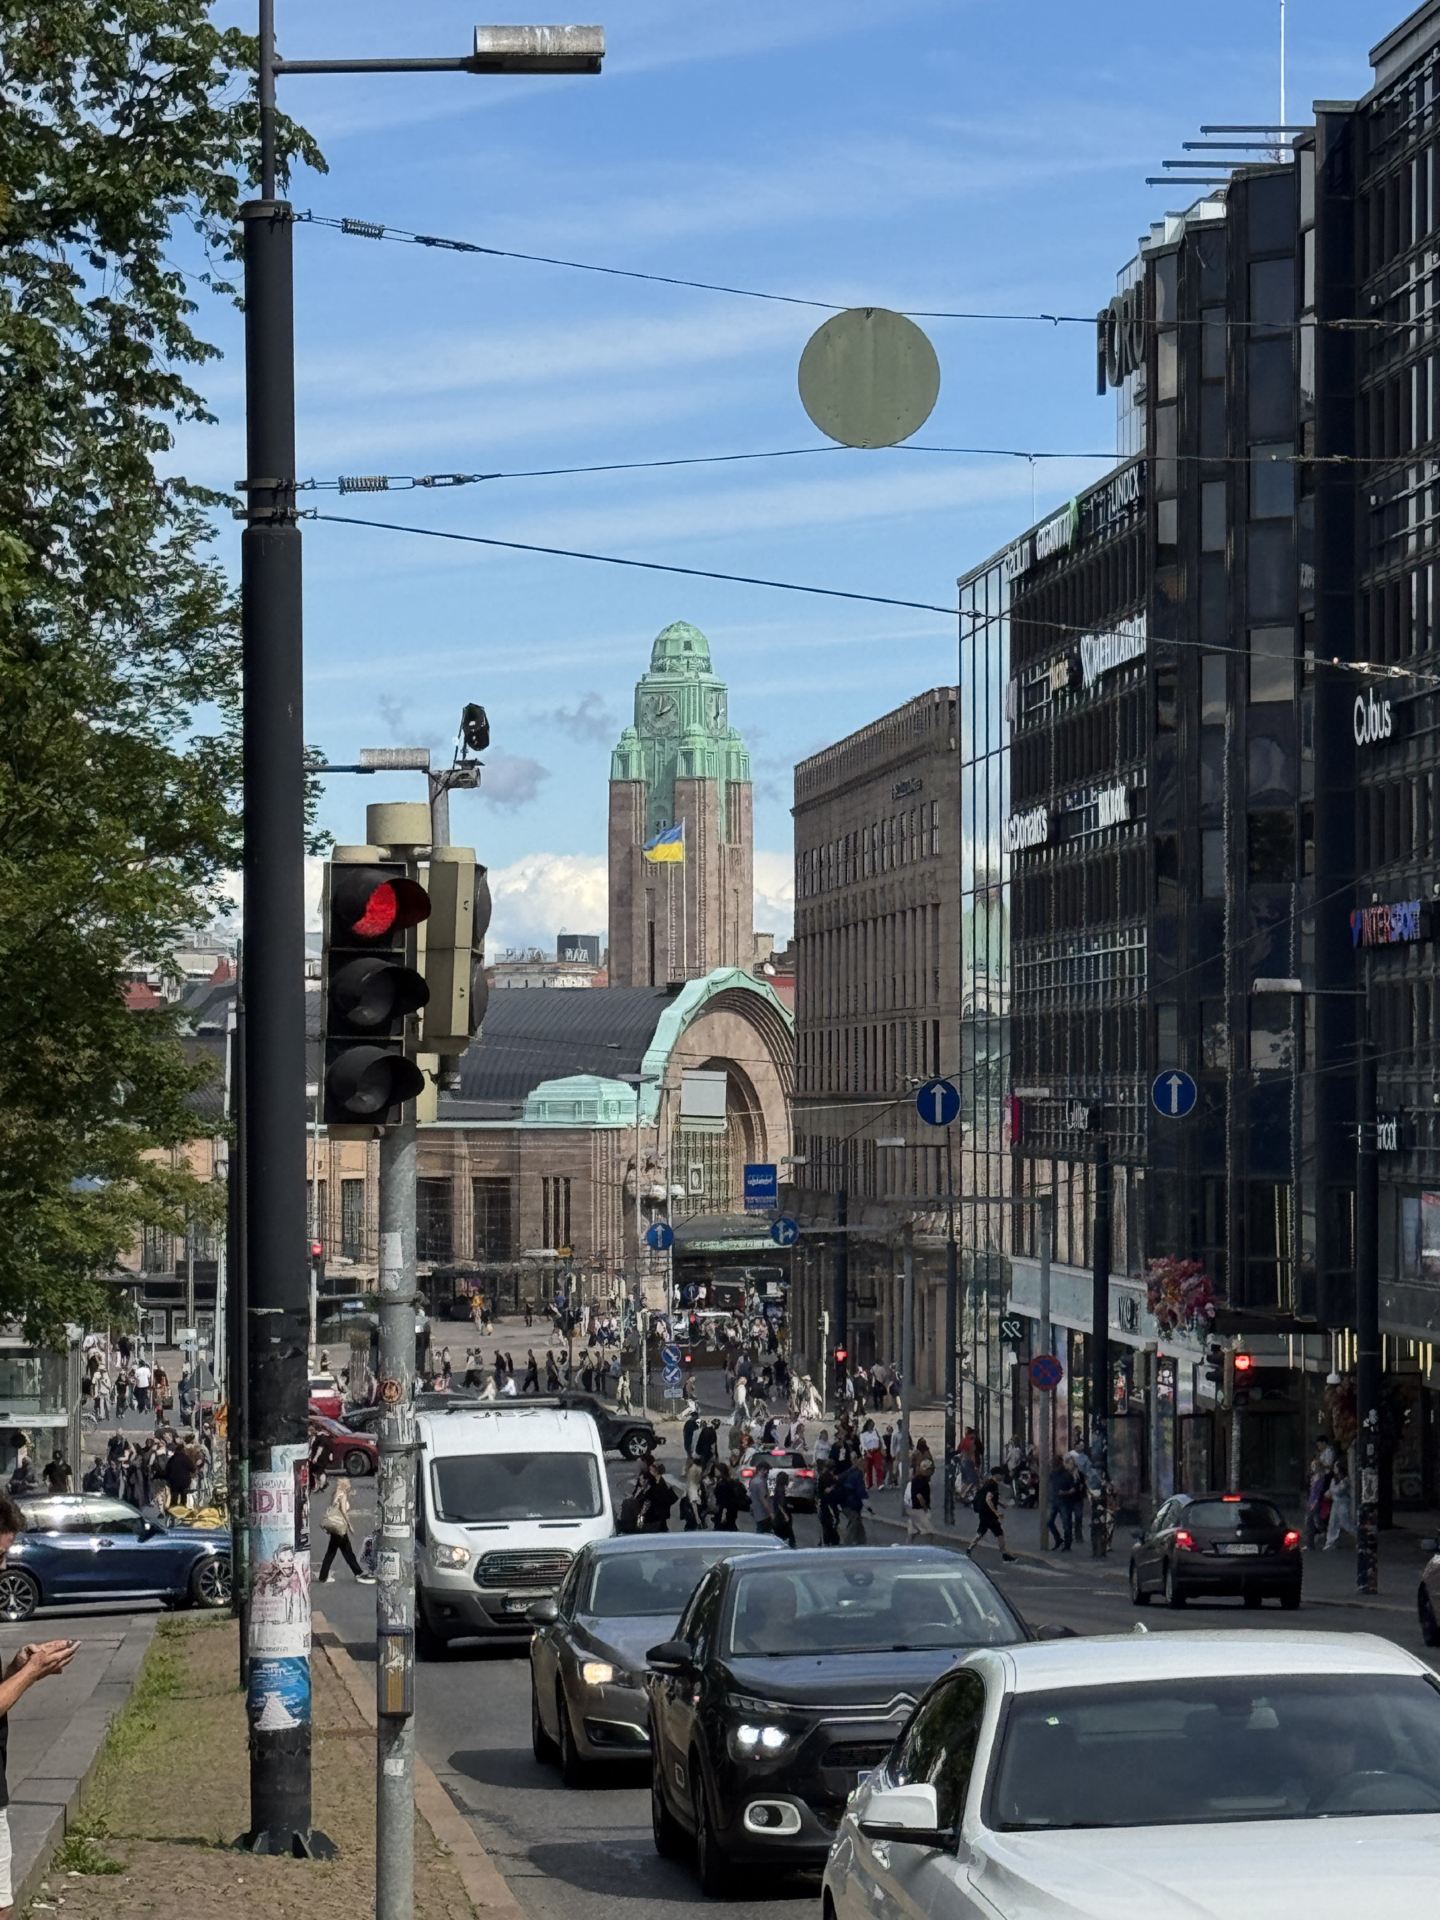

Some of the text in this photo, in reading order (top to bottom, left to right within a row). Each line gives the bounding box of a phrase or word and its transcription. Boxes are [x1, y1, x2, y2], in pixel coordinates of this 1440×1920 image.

[1097, 279, 1146, 395] FORU
[1110, 465, 1140, 512] LINDEX
[1354, 687, 1392, 746] Cubus
